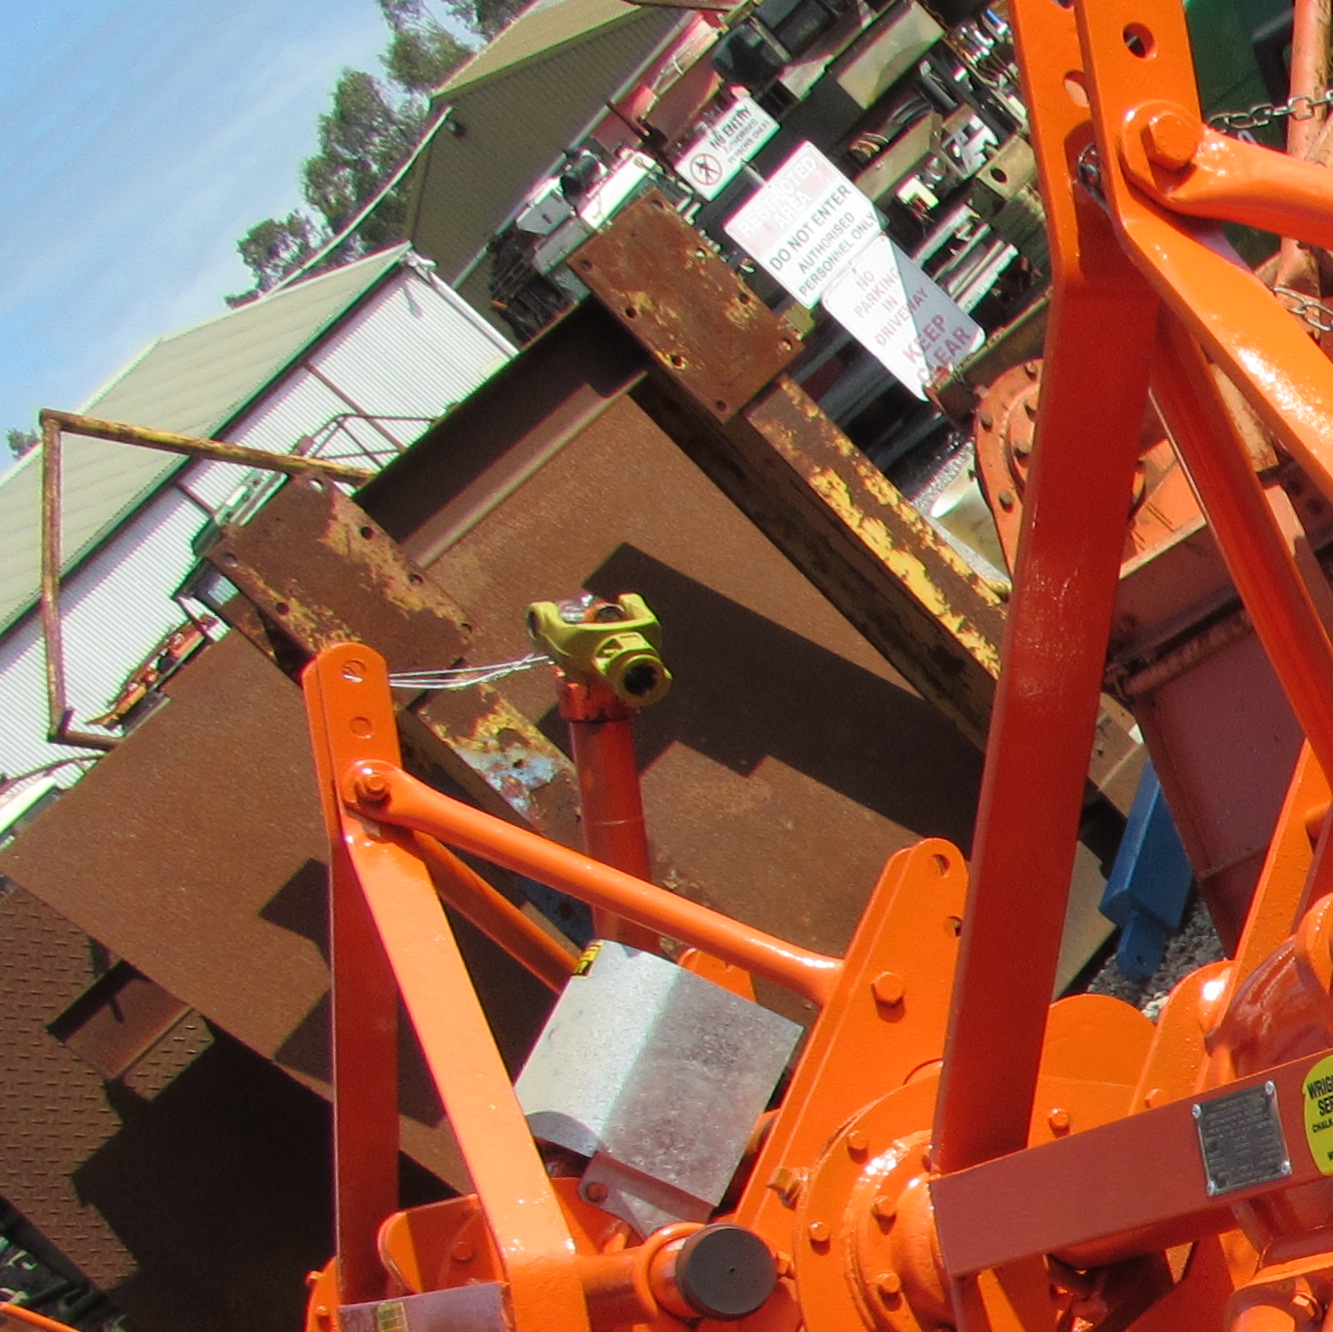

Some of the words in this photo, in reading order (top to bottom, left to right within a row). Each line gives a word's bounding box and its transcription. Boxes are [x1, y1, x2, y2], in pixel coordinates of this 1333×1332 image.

[739, 154, 818, 235] RESTRICTED
[775, 190, 812, 229] AREA
[769, 248, 792, 271] DO
[788, 222, 816, 249] NOT
[811, 184, 852, 226] ENTER
[799, 212, 855, 275] AUTHORISED
[799, 239, 854, 297] PERSONNEL
[851, 211, 879, 240] ONLY
[855, 269, 876, 292] NO
[881, 296, 899, 313] IN
[874, 287, 929, 346] DRIVEWAY
[902, 314, 946, 364] KEEP
